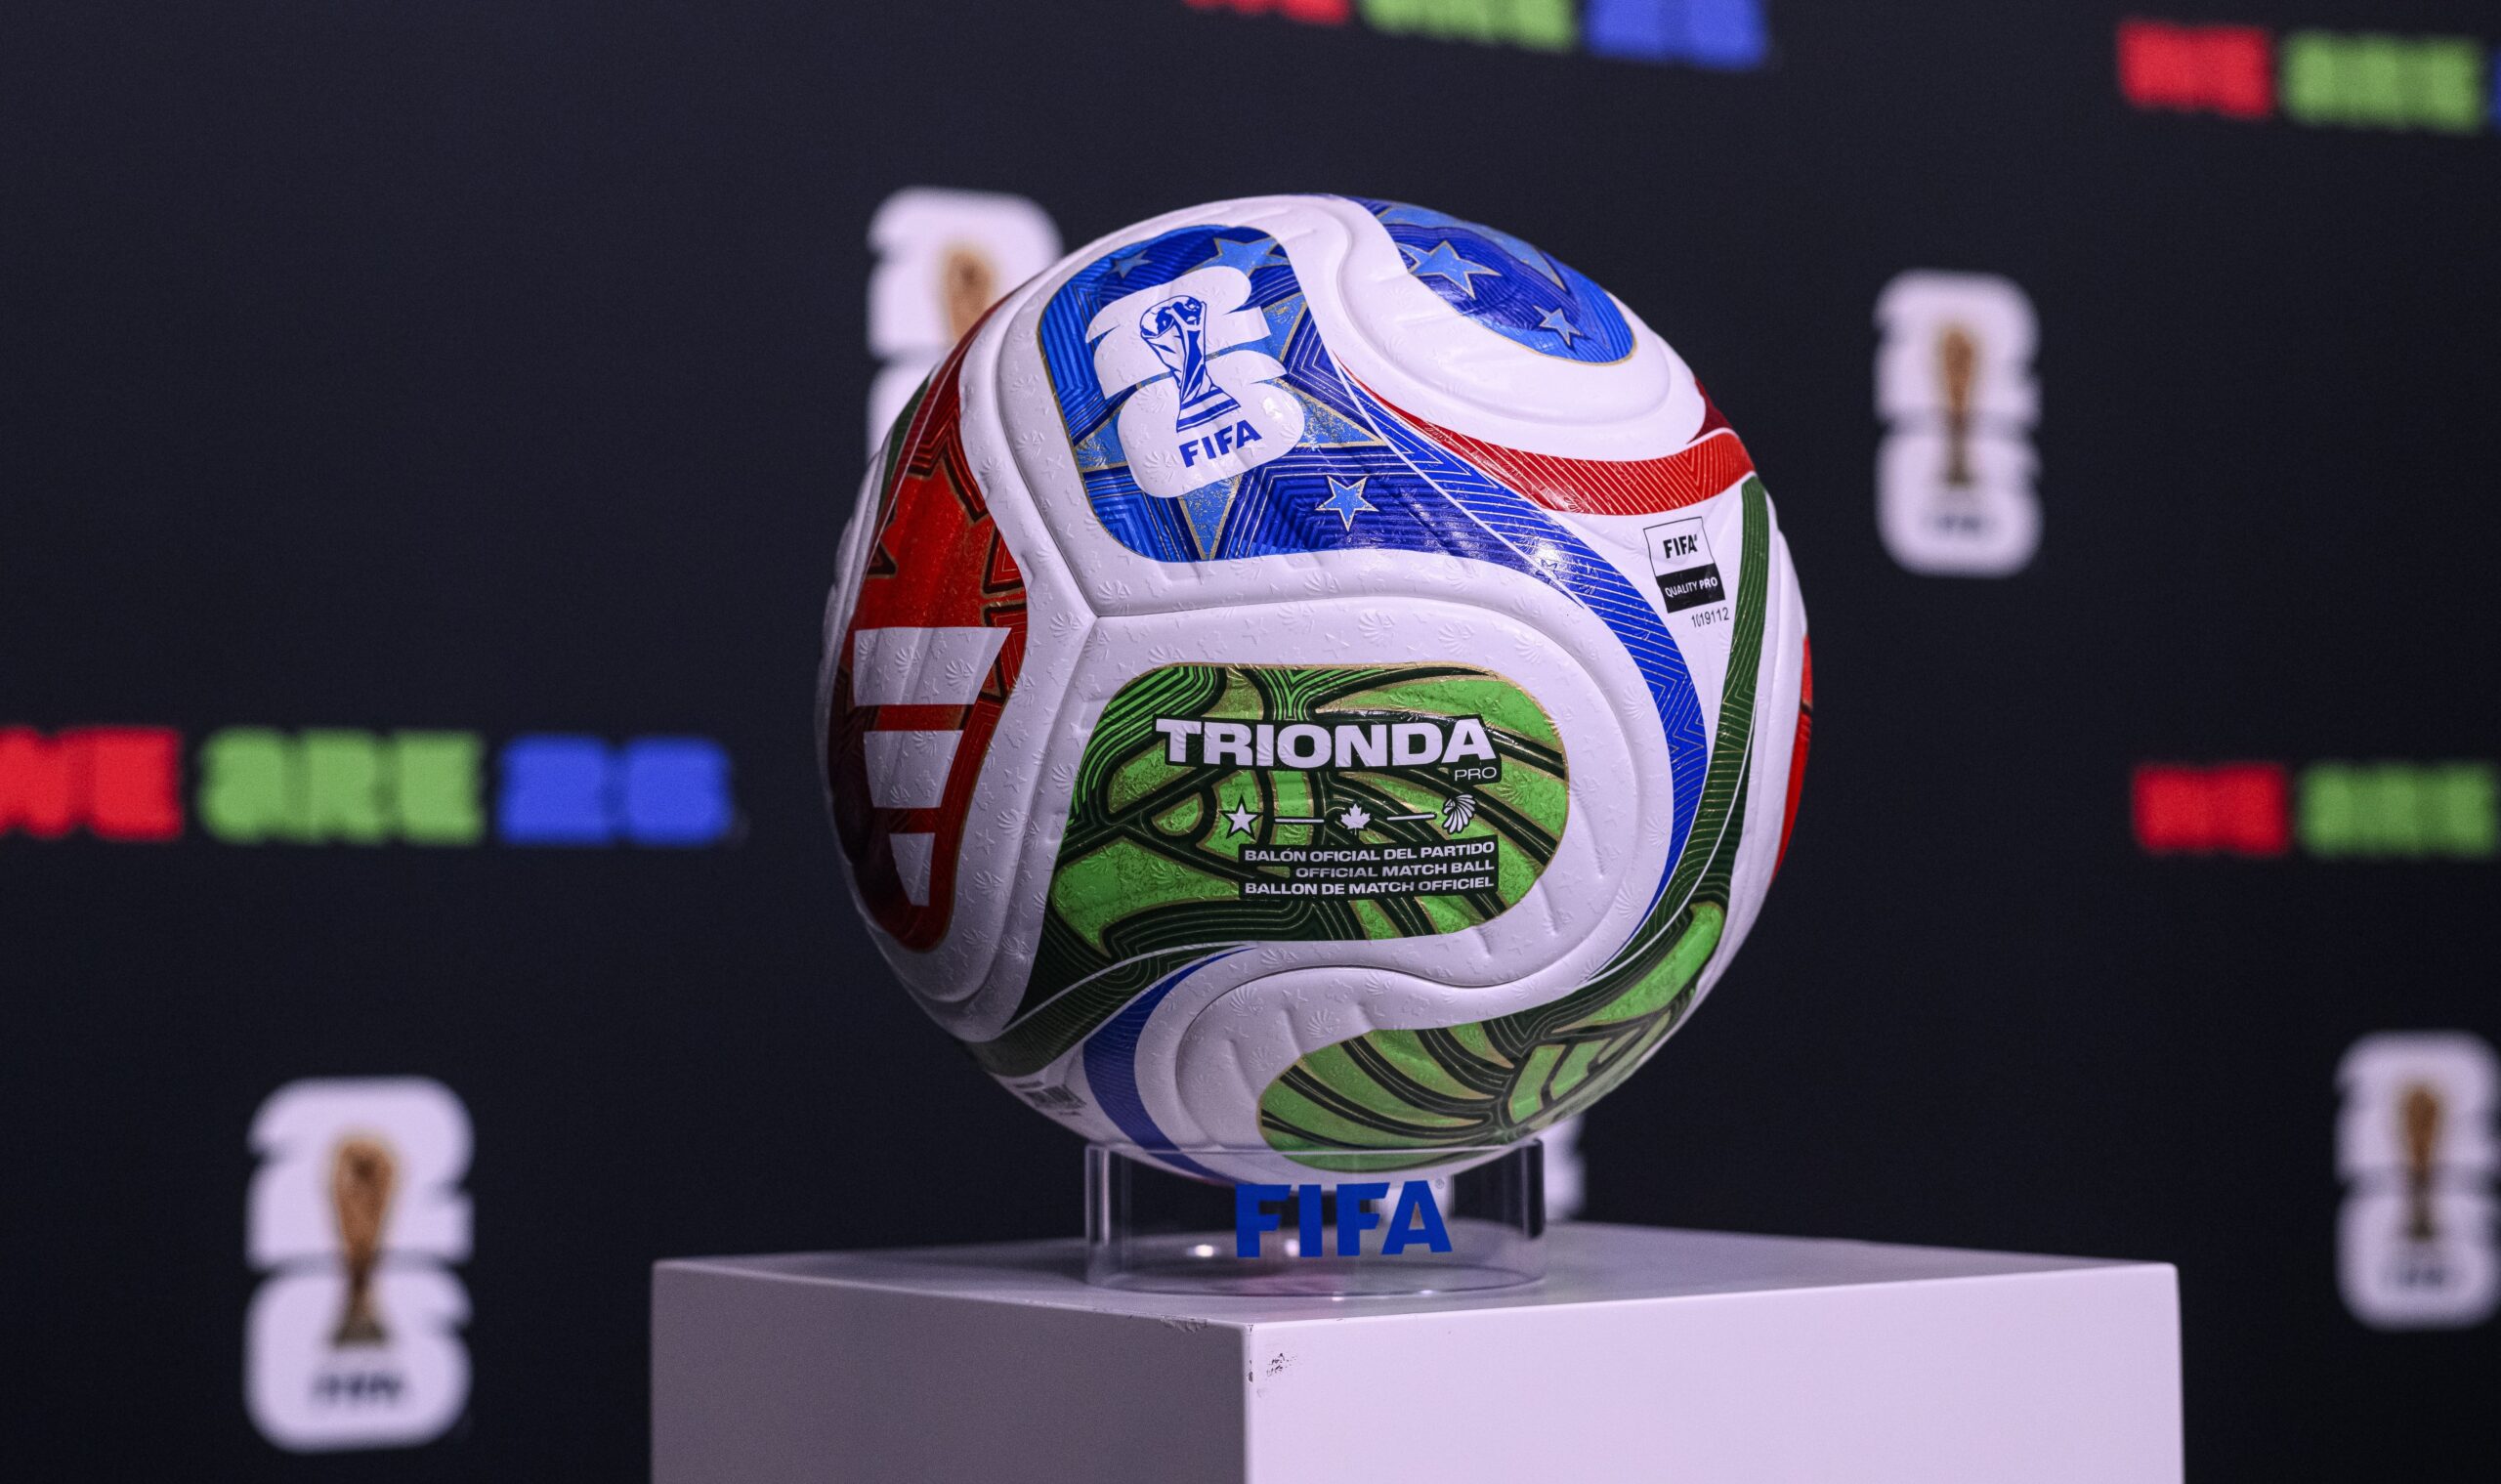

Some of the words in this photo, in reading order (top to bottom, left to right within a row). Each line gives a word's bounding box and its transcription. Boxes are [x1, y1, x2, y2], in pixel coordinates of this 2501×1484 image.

[1178, 420, 1262, 467] FIFA
[1663, 534, 1697, 559] FIFA
[1665, 581, 1698, 598] QUALITY
[1699, 576, 1717, 590] PRO
[1157, 718, 1496, 768] TRIONDA
[1455, 766, 1497, 782] PRO
[1245, 848, 1306, 862] BALÓN
[1309, 850, 1380, 863] OFICIAL
[1383, 848, 1417, 861] DEL
[1420, 841, 1495, 859] PARTIDO
[1295, 867, 1378, 878] OFFICIAL
[1381, 863, 1447, 877] MATCH
[1451, 859, 1495, 873] BALL
[1245, 882, 1318, 895] BALLON
[1321, 883, 1345, 895] DE
[1348, 881, 1415, 894] MATCH
[1418, 876, 1495, 891] OFFICIEL
[1235, 1180, 1453, 1257] FIFA
